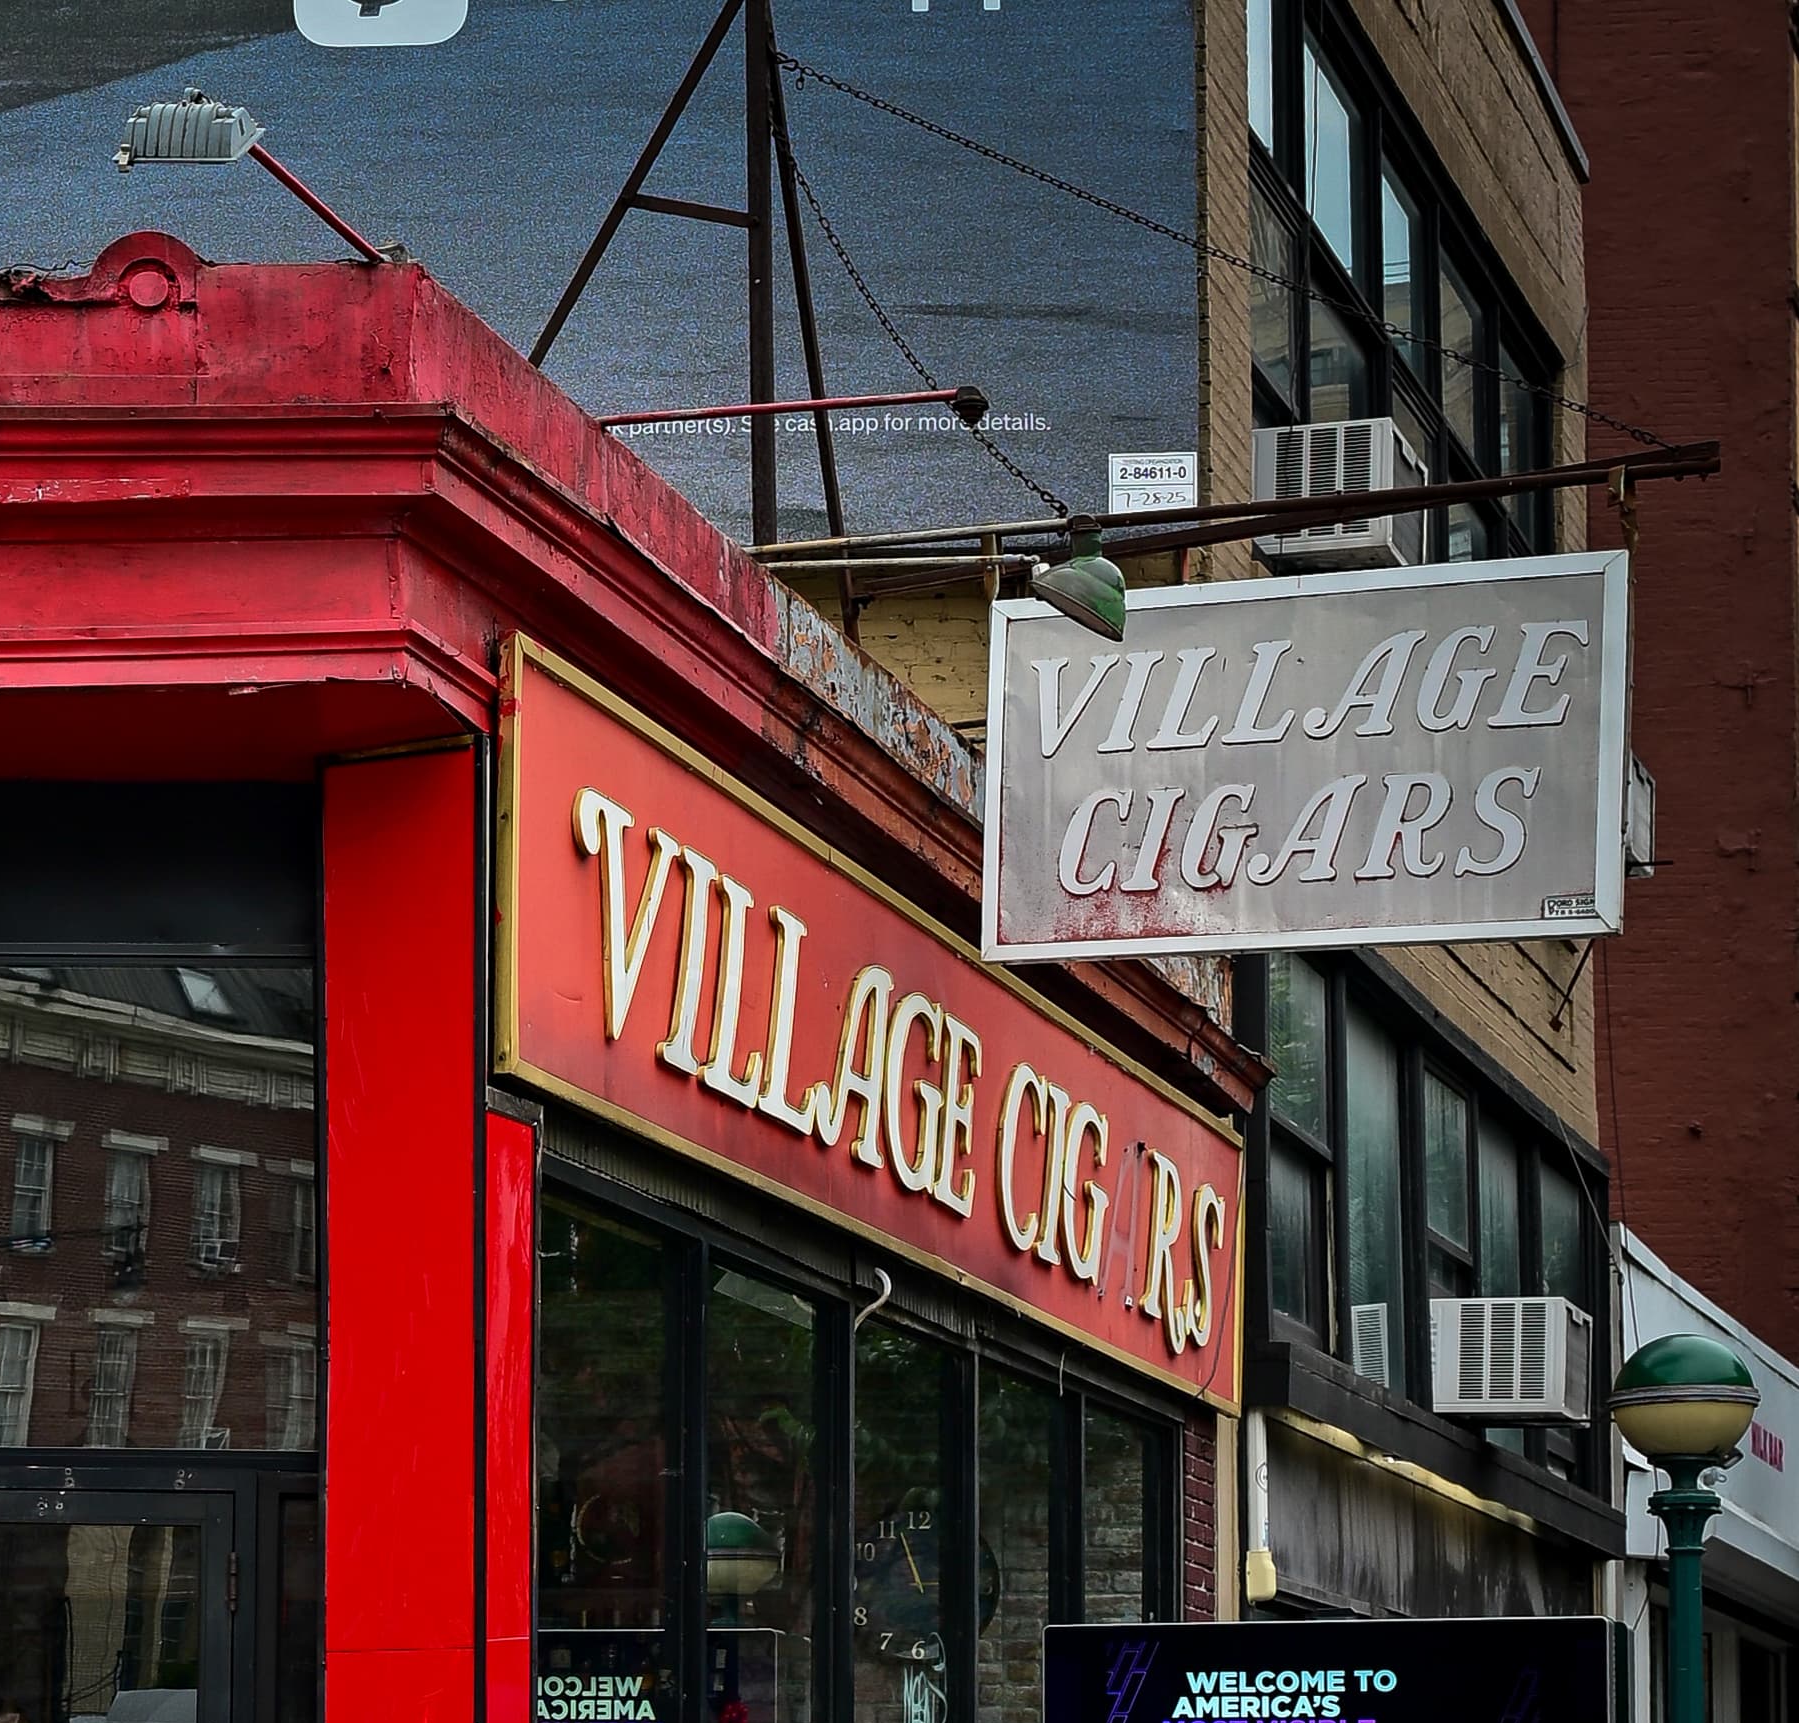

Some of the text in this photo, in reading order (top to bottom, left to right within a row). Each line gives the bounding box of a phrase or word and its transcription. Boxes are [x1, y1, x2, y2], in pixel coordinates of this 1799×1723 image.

[785, 413, 879, 436] cas.app
[885, 412, 910, 432] for
[977, 412, 1052, 432] details.
[1119, 465, 1187, 480] 2-84611-0
[1031, 619, 1590, 759] VILLAGE
[1058, 766, 1543, 896] CIGARS
[572, 785, 984, 1220] VILLAGE
[876, 1520, 898, 1540] 11
[906, 1511, 932, 1530] 12
[856, 1542, 876, 1562] 10
[853, 1606, 868, 1626] 8
[880, 1632, 894, 1651] 7
[911, 1640, 926, 1660] 6
[1185, 1670, 1398, 1694] WELCOME TO
[1171, 1695, 1341, 1719] AMERICA'S
